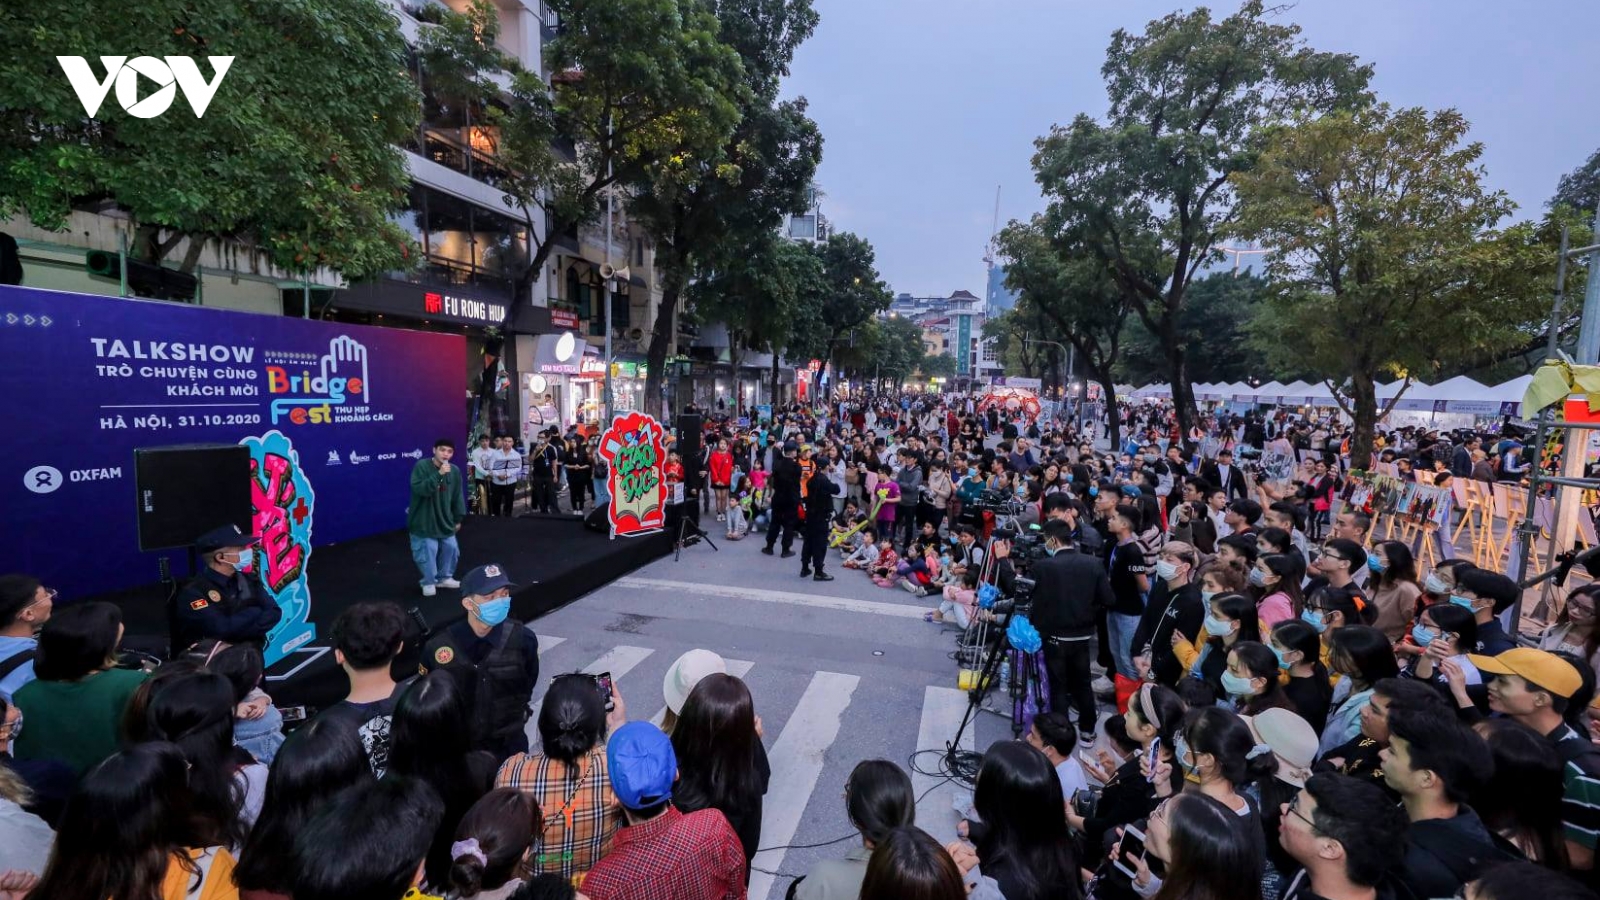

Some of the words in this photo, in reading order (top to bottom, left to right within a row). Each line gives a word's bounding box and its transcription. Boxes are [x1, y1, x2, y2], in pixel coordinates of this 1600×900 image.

[444, 296, 459, 316] FU
[461, 299, 486, 320] RONG
[90, 337, 255, 364] TALKSHOW
[96, 363, 133, 378] TRÒ
[140, 365, 208, 381] CHUYỆN
[213, 366, 258, 379] CÙNG
[166, 383, 225, 396] KHÁCH
[230, 384, 259, 396] MỜI
[266, 366, 363, 399] Bridge
[271, 399, 332, 425] Fest
[335, 406, 352, 415] THU
[100, 414, 128, 429] HÀ
[134, 413, 172, 431] NỘI,
[178, 413, 261, 427] 31.10.2020
[70, 466, 122, 483] OXFAM
